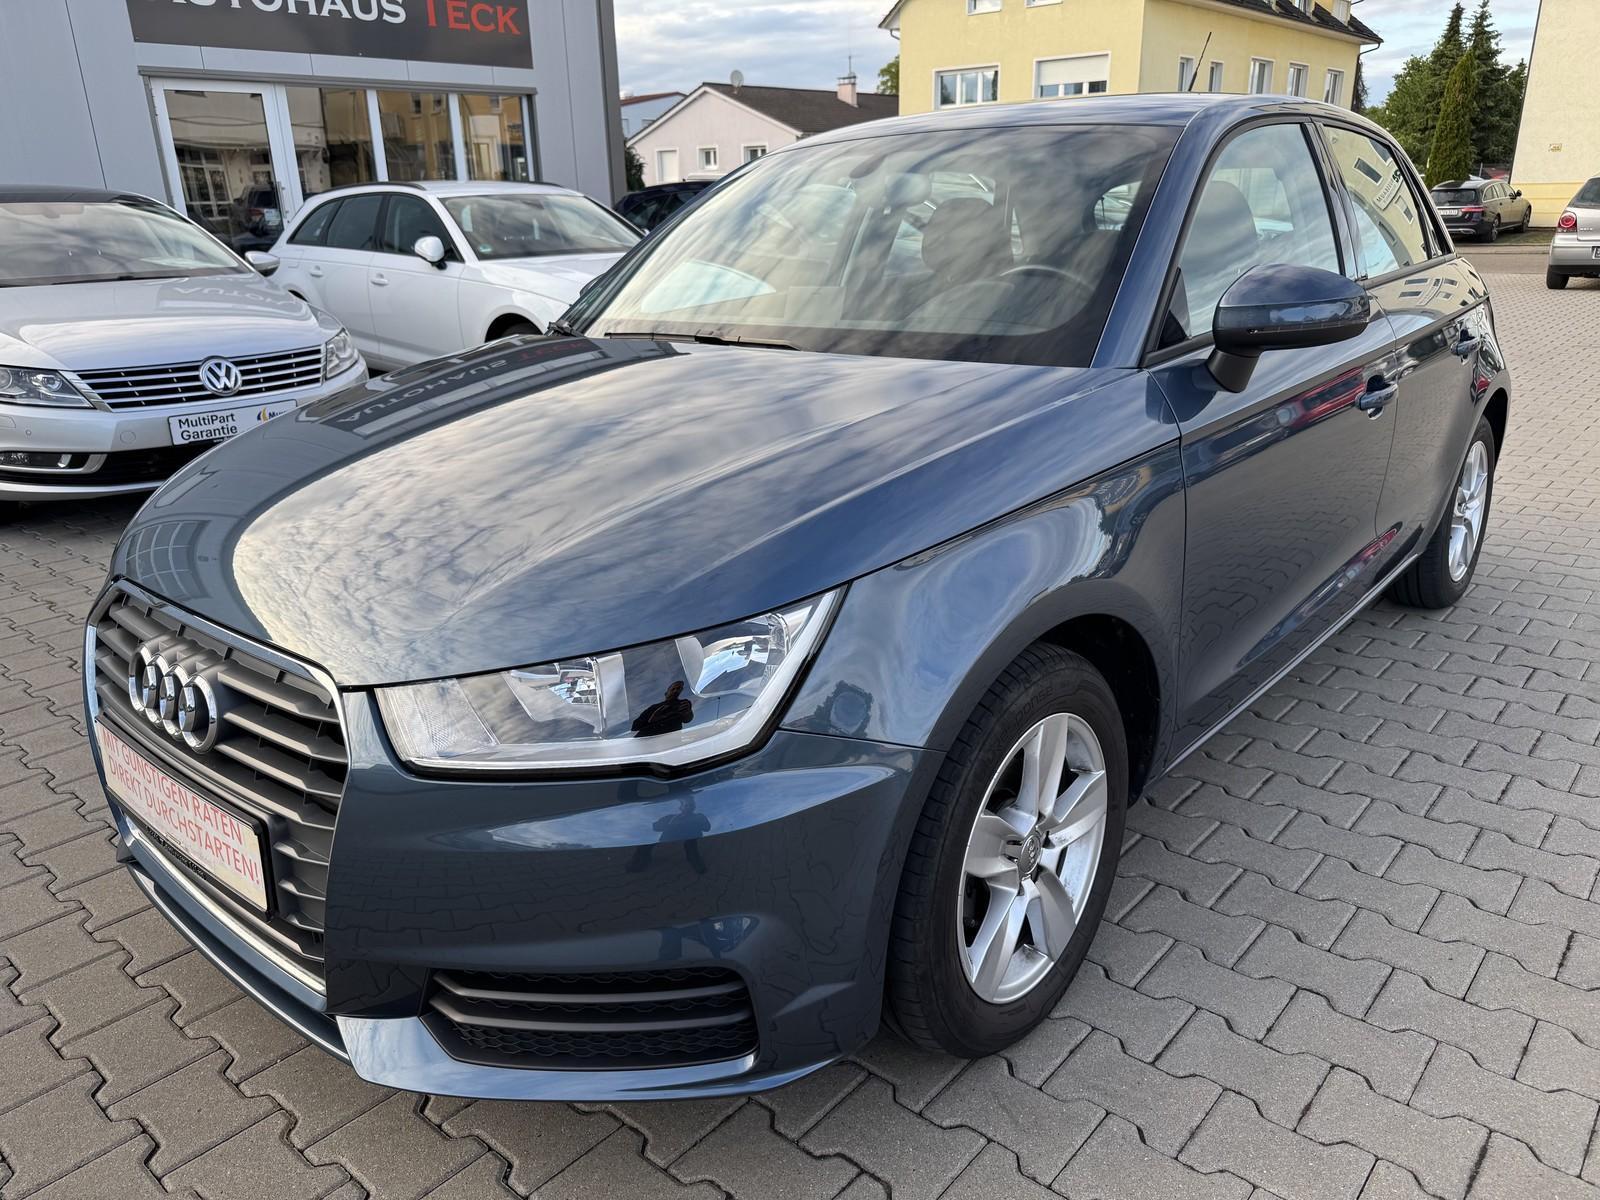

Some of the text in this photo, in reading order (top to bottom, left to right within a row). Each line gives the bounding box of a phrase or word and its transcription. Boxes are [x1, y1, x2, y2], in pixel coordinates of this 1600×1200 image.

[172, 0, 406, 24] HAUS
[178, 413, 236, 429] MultiPart
[181, 425, 238, 441] Garantie
[102, 727, 120, 757] MIT
[192, 795, 243, 845] RATEN
[108, 755, 143, 801] DIREKT
[144, 786, 260, 885] DURCHSTARTEN!
